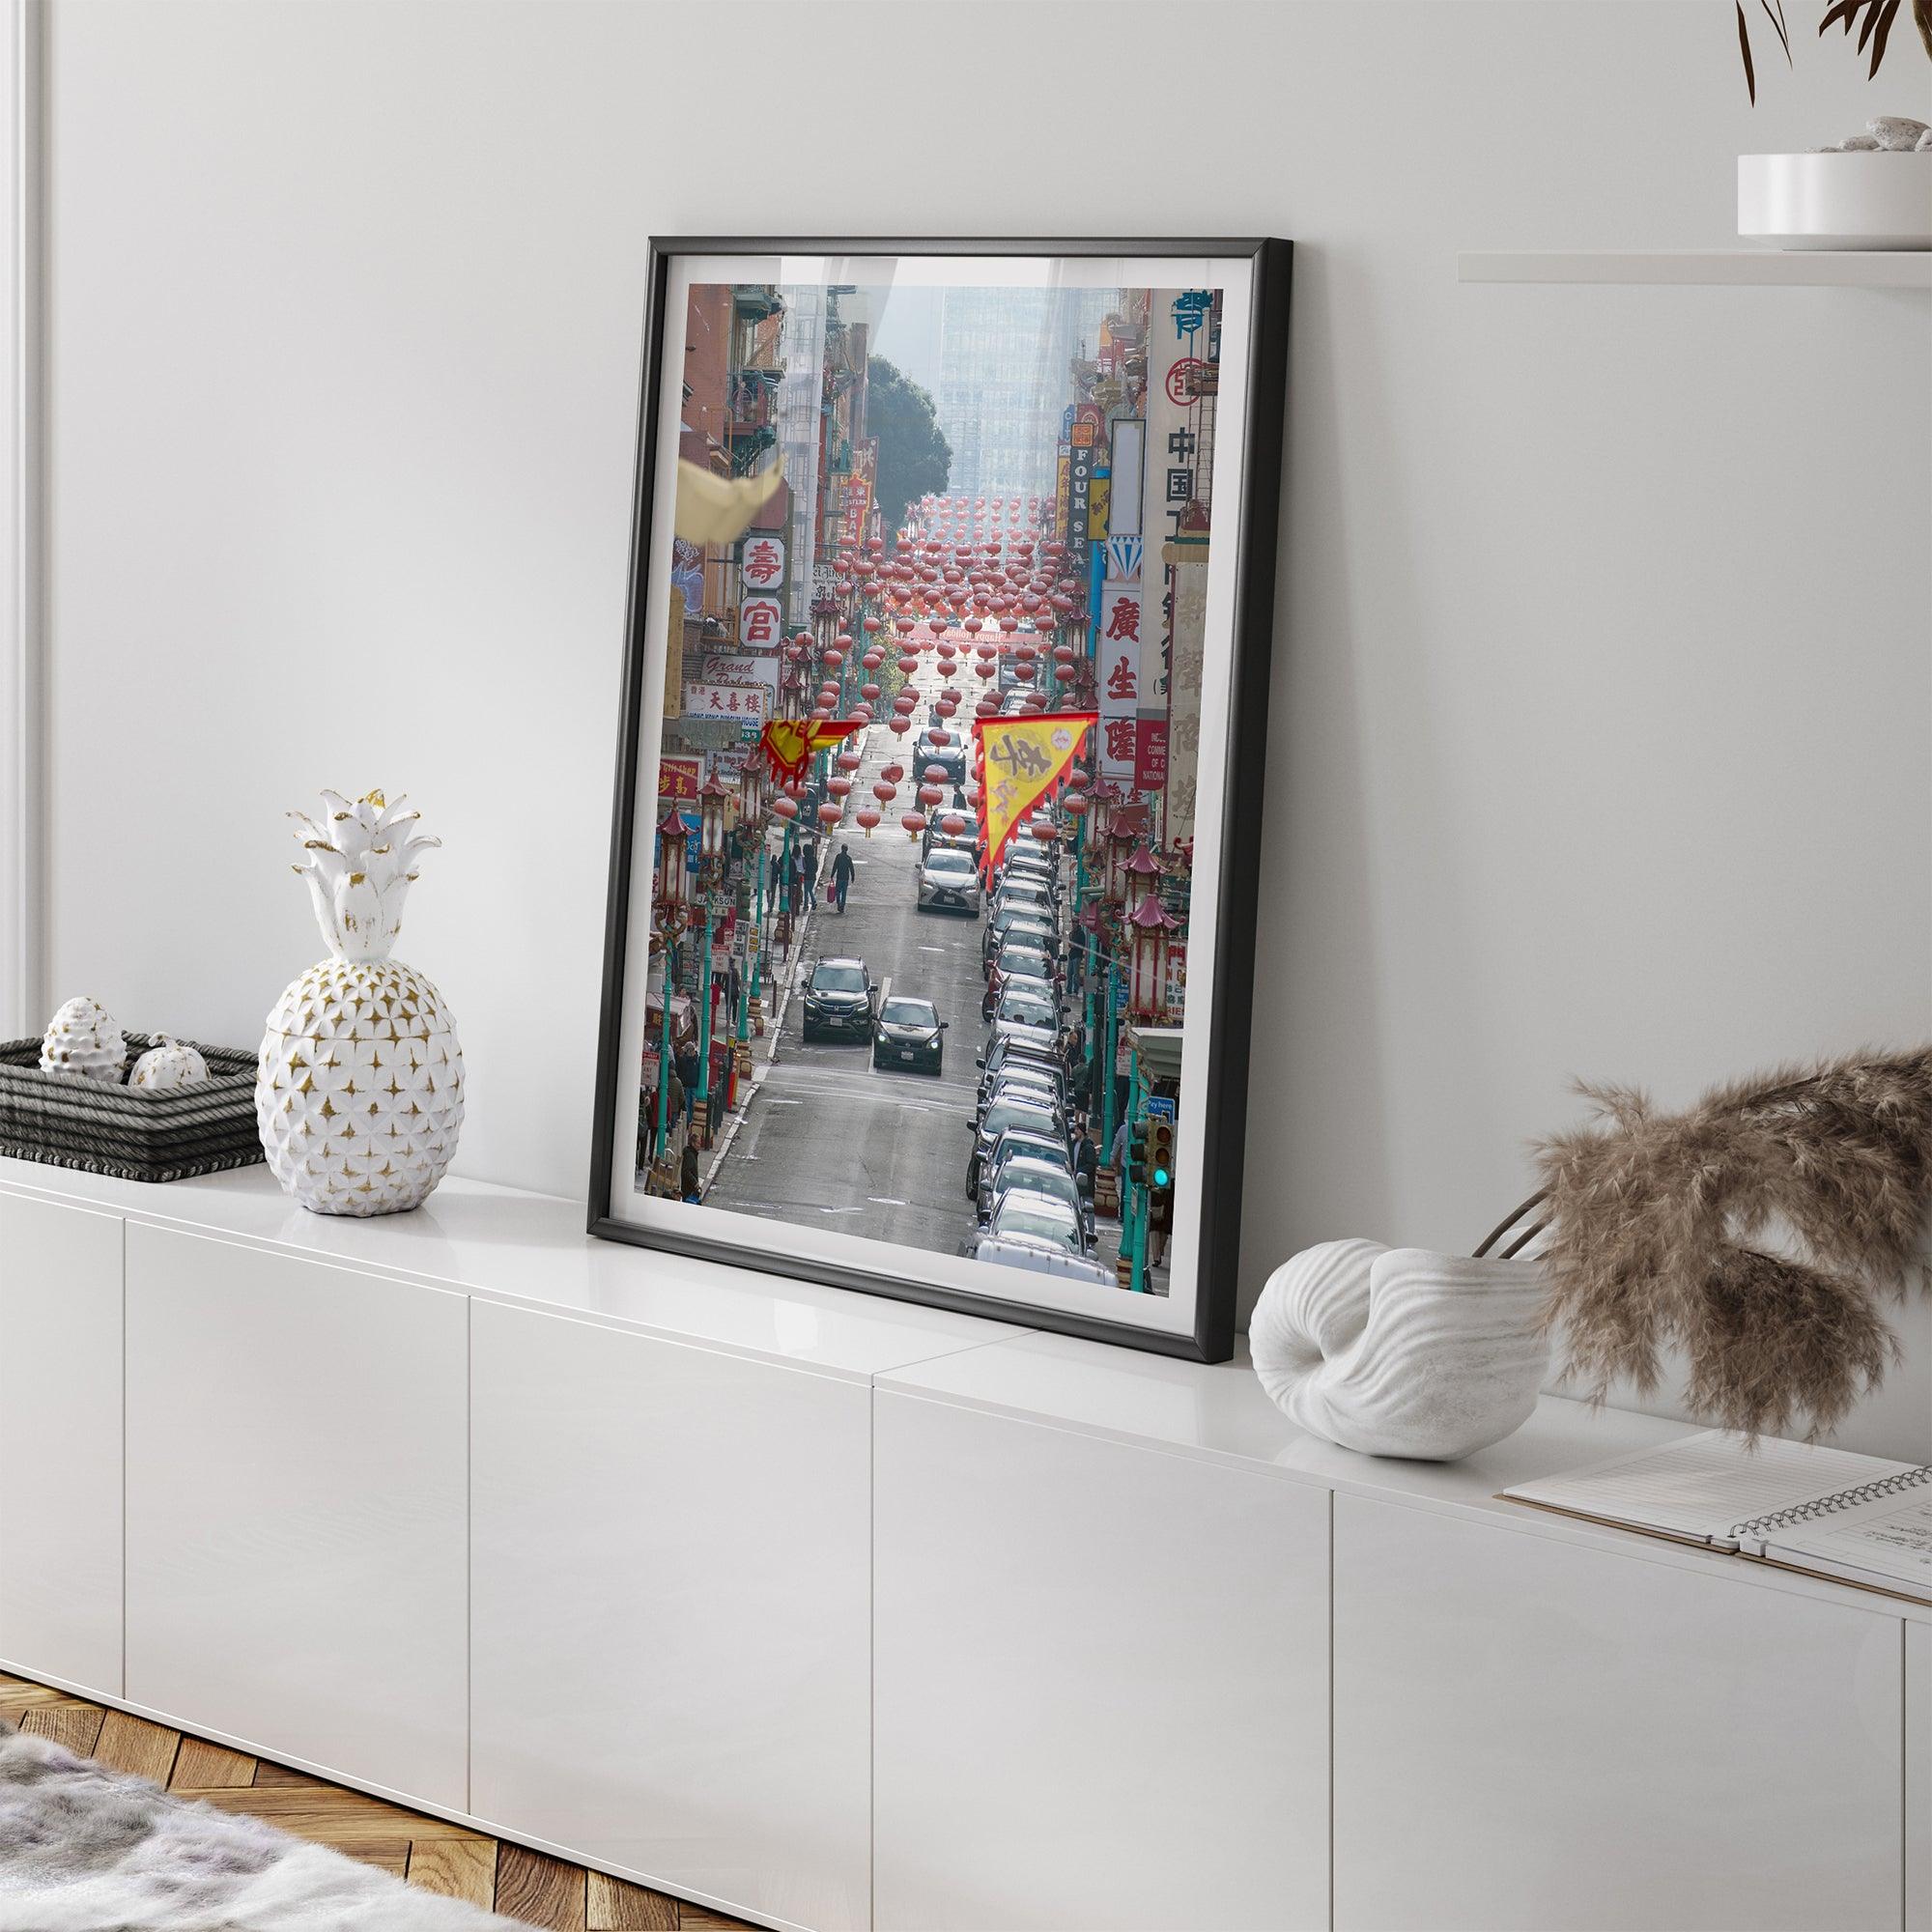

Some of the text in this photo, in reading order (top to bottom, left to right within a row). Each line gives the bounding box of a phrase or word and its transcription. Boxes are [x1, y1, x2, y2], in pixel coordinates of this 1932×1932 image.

[1073, 449, 1088, 509] FOUR
[706, 657, 754, 674] Grand
[697, 895, 736, 906] JAKSON
